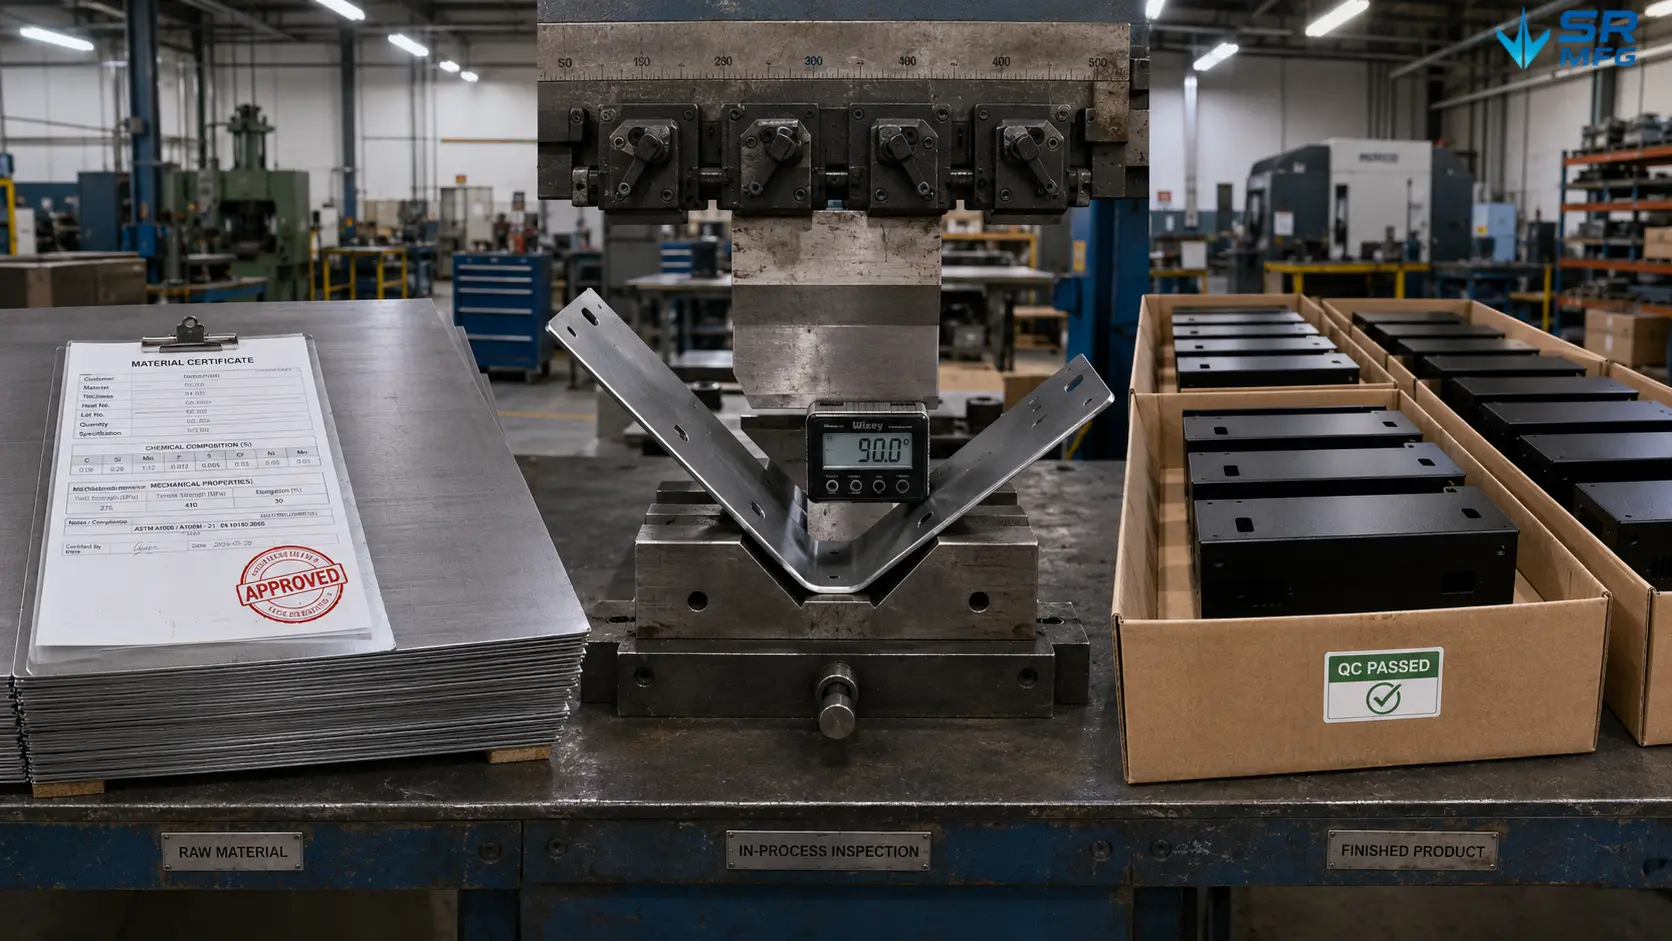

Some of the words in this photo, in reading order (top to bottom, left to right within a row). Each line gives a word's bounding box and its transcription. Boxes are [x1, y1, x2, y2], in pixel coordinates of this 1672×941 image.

[131, 359, 185, 368] MATERIAL
[187, 356, 255, 366] CERTIFICATE
[852, 421, 883, 431] Wixey
[150, 481, 200, 489] MECHANICAL
[246, 567, 341, 602] APPROVED
[1337, 662, 1362, 676] QC
[1367, 659, 1430, 675] PASSED
[179, 846, 212, 859] RAW
[216, 846, 288, 858] MATERIAL
[739, 844, 828, 857] IN-PROCESS
[831, 845, 920, 858] INSPECTION
[1341, 844, 1409, 857] FINISHED
[1413, 845, 1486, 858] PRODUCT
